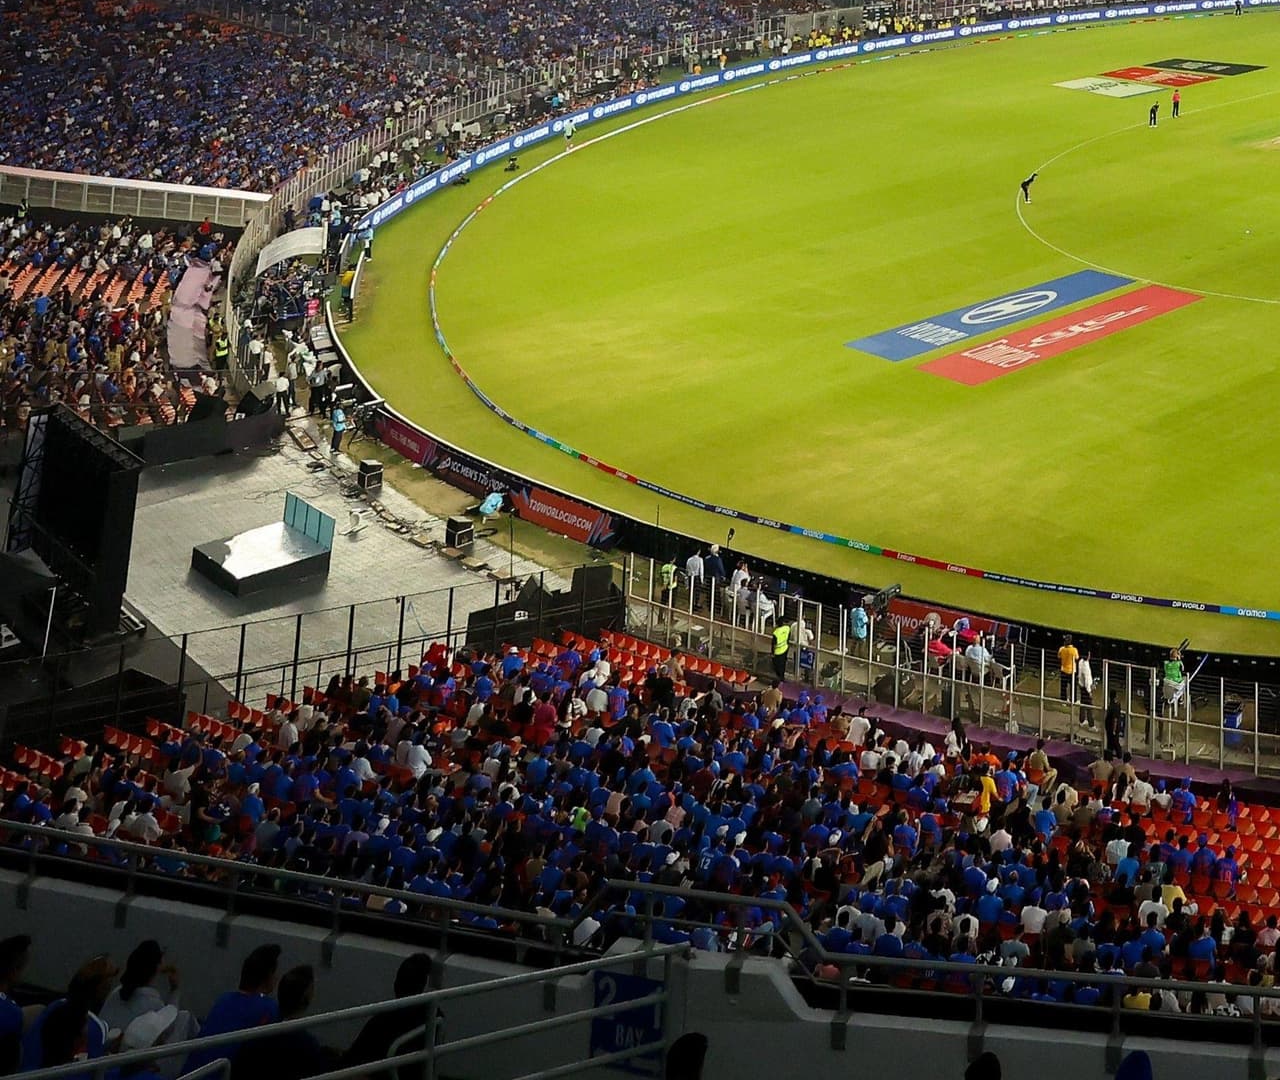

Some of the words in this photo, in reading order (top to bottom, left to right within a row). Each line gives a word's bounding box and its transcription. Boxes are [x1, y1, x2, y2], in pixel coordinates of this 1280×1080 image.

[529, 498, 593, 532] T20WORLDCUP.COM
[1120, 594, 1143, 603] WORLD
[1182, 602, 1205, 610] WORLD
[1238, 607, 1267, 618] aramco
[615, 1023, 645, 1048] BAY
